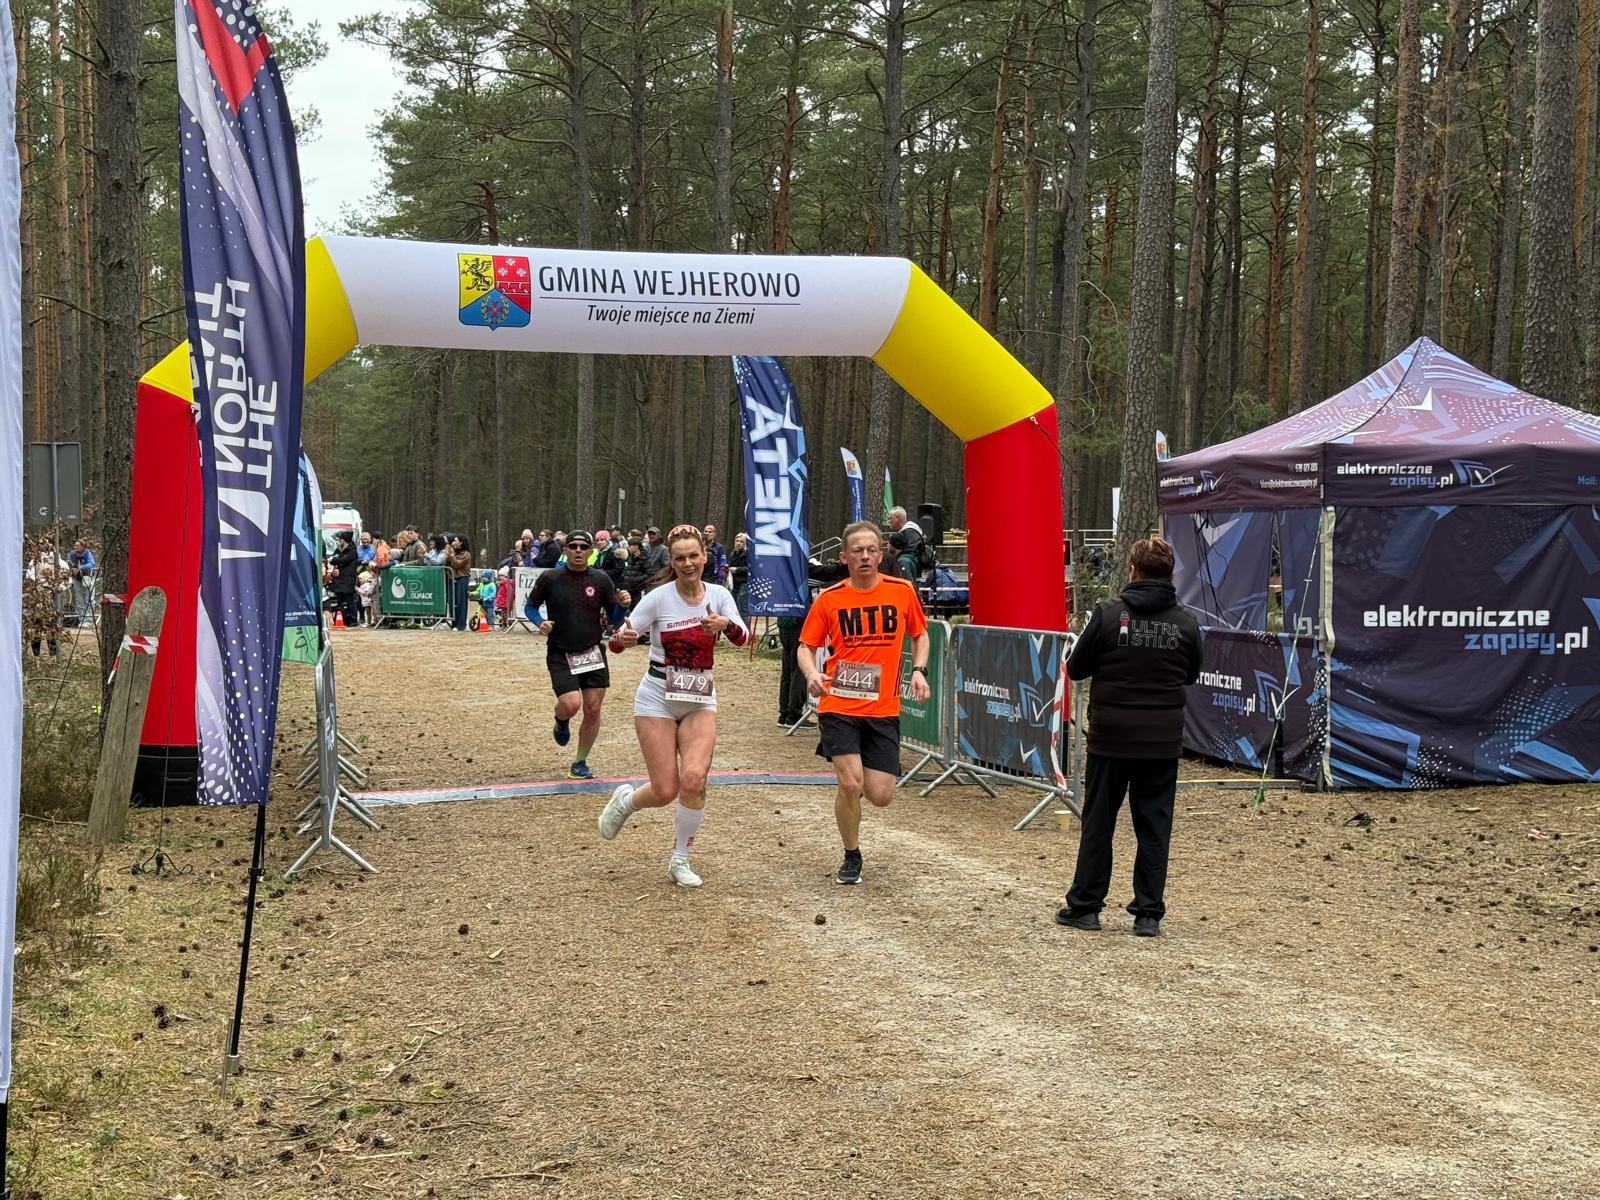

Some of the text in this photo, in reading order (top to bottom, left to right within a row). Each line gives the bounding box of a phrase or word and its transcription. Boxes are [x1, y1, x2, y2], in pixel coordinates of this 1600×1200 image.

[539, 266, 801, 298] GMINA WEJHEROWO
[587, 305, 756, 326] Twoje miejsce na Ziemi
[1337, 463, 1432, 475] elektroniczne
[1389, 473, 1453, 488] zapisy.pl
[838, 605, 898, 638] MTB
[1363, 604, 1550, 627] elektroniczne
[1131, 619, 1182, 638] ULTRA
[1130, 632, 1179, 650] STILO
[1464, 626, 1589, 656] zapisy.pl
[573, 651, 597, 666] 524
[673, 674, 708, 691] 479
[837, 669, 873, 689] 444
[1212, 691, 1256, 717] zapisy.pl
